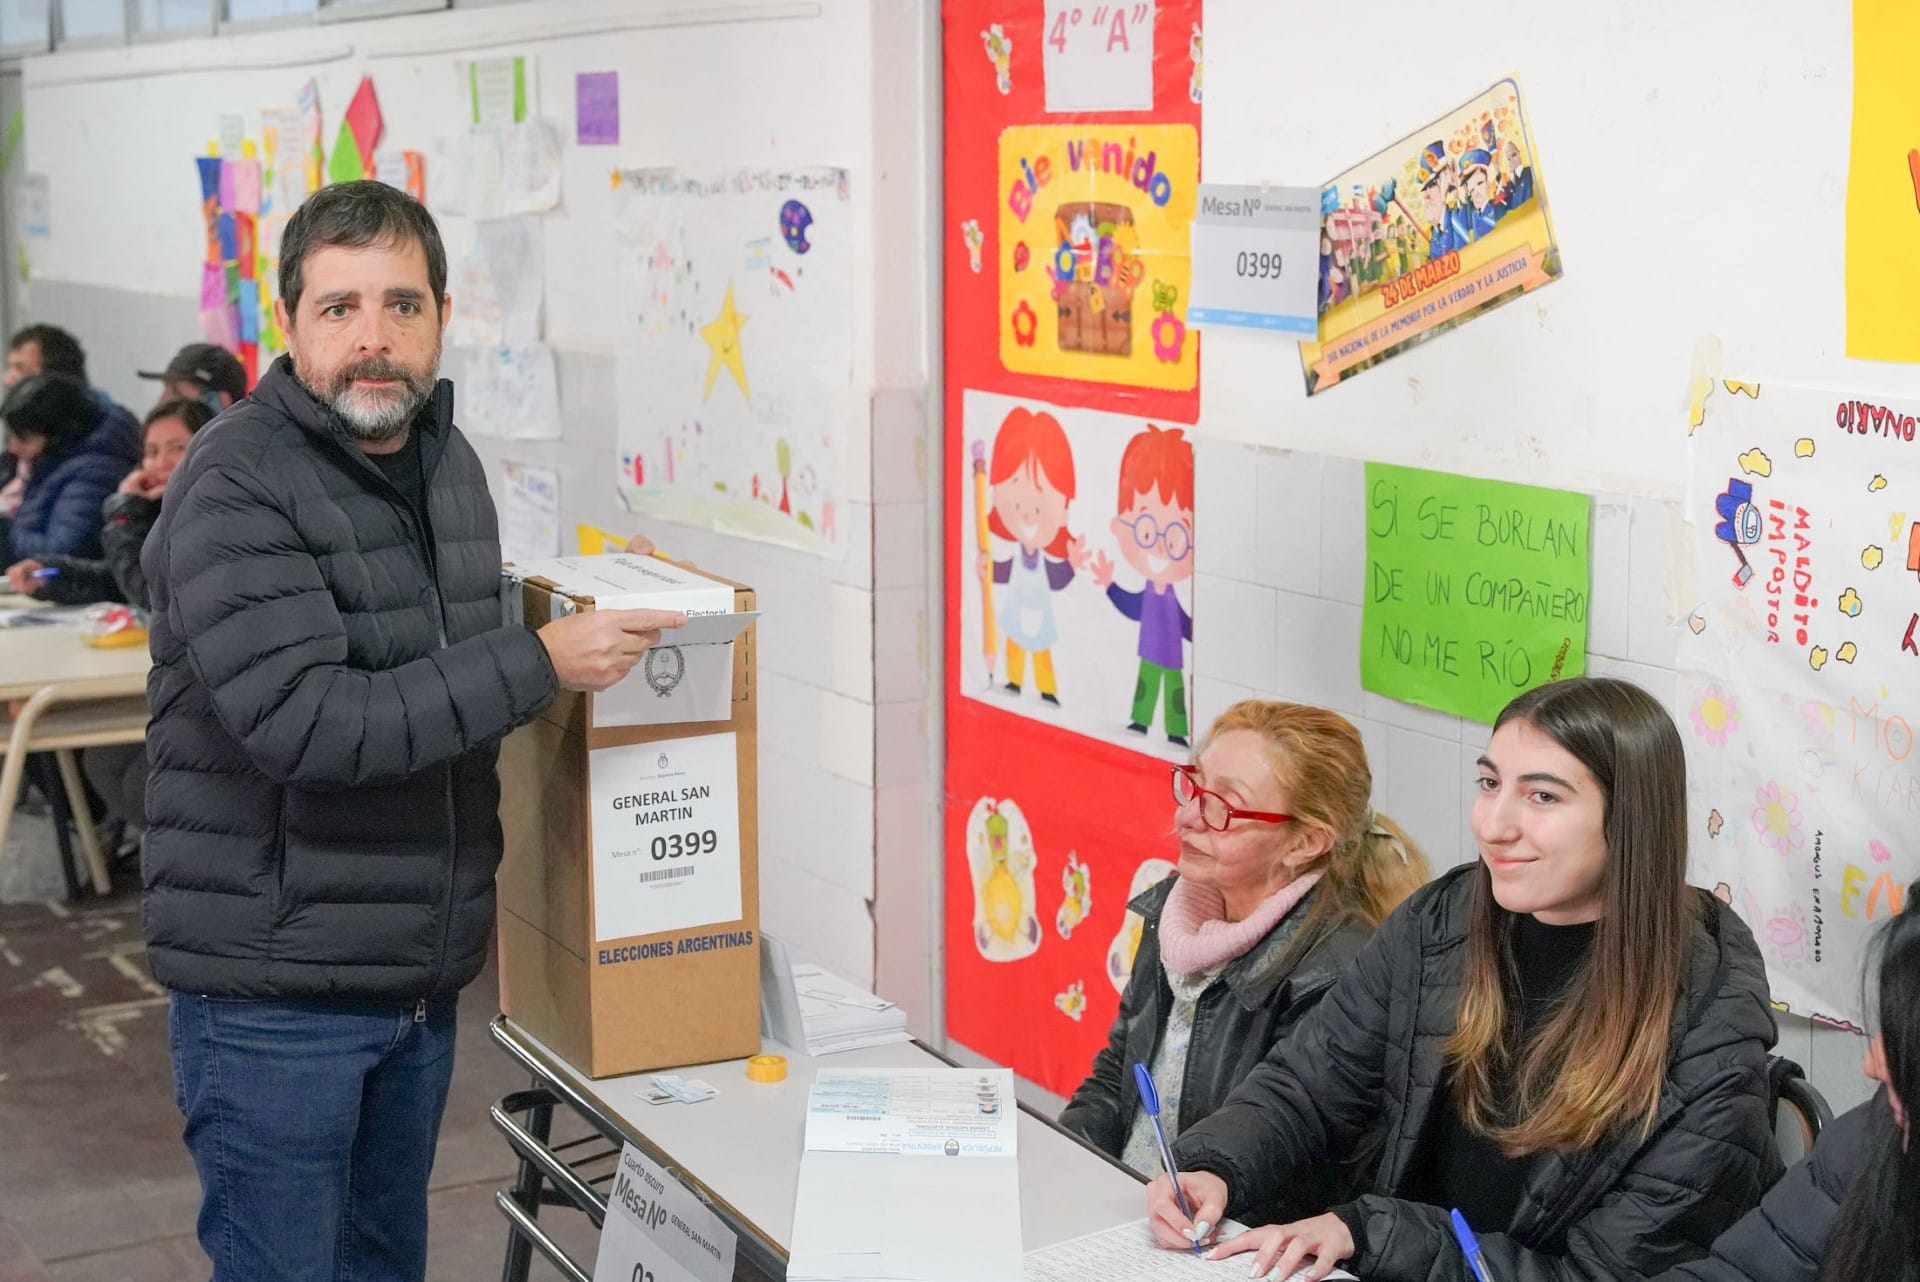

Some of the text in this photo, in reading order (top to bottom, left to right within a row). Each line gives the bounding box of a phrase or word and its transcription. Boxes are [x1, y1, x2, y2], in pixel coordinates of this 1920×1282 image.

[1202, 196, 1240, 217] Mesa
[1236, 251, 1283, 280] 0399
[1381, 249, 1461, 310] 24 DE MARZO
[1340, 336, 1369, 358] NACIONAL
[1370, 328, 1379, 343] DE
[1380, 325, 1390, 339] LA
[1391, 309, 1422, 332] MEMORIA
[1438, 295, 1448, 310] LA
[1448, 282, 1475, 305] VERDAD
[1476, 278, 1482, 291] Y
[1484, 273, 1494, 288] LA
[1497, 257, 1528, 282] JUSTICIA
[1418, 496, 1459, 541] SE
[1476, 504, 1577, 558] BURLAN
[1373, 560, 1584, 624] DE UN COMPAÑERO
[686, 608, 727, 618] Electoral
[1381, 624, 1413, 666] NO
[1424, 631, 1460, 677] ME
[613, 785, 711, 811] GENERAL SAN
[635, 806, 693, 826] MARTIN
[611, 849, 630, 859] Mesa
[651, 829, 718, 861] 0399
[599, 930, 753, 966] ELECCIONES ARGENTINAS
[624, 1153, 665, 1195] Cuarto oscuro
[615, 1172, 647, 1220] Mesa
[671, 1214, 691, 1238] GENERAL
[690, 1230, 701, 1246] SAN
[701, 1239, 721, 1261] MARTIN
